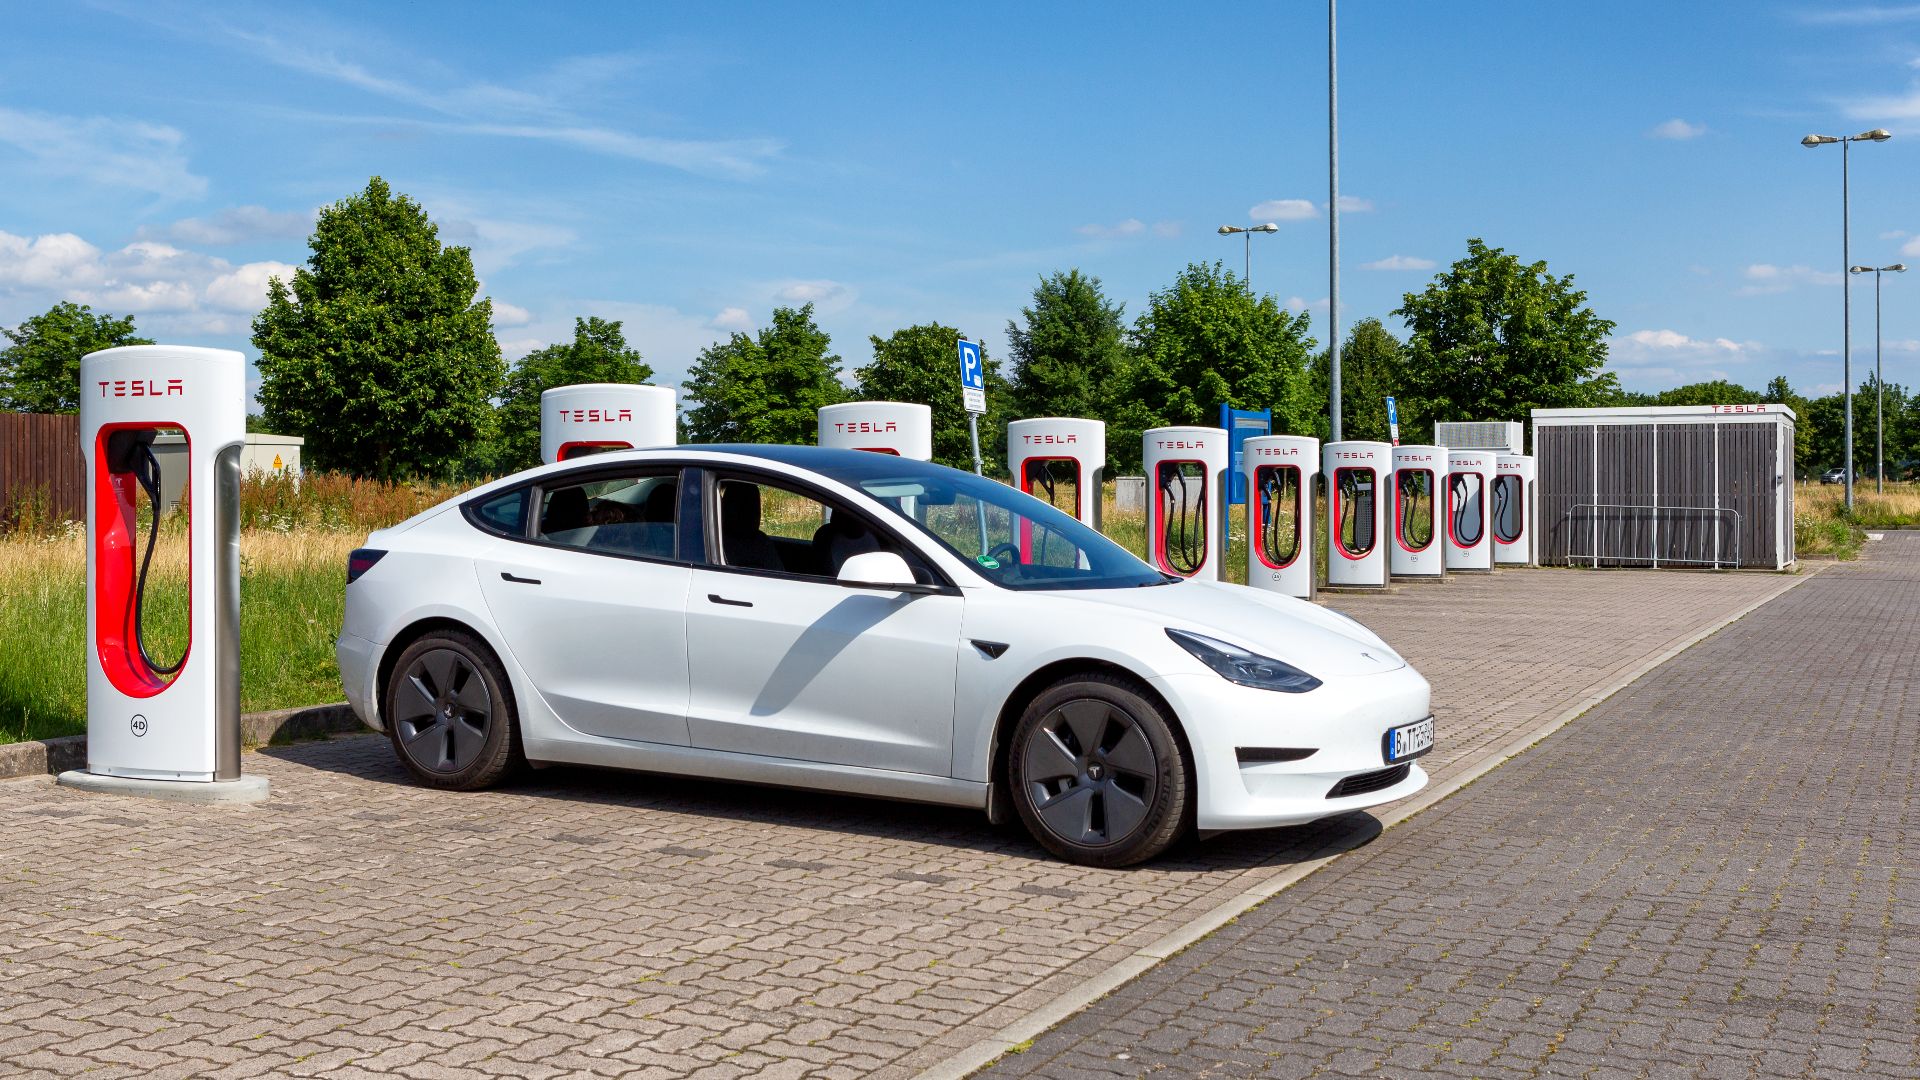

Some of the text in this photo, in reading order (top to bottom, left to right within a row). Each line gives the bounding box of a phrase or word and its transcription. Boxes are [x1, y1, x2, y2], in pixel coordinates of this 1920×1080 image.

[964, 347, 976, 382] P
[98, 380, 182, 397] TESLA
[1712, 404, 1766, 413] TESLA
[559, 409, 632, 422] TESLA
[834, 422, 896, 433] TESLA
[1022, 434, 1077, 445] TESLA
[1157, 441, 1204, 449] TESLA
[1255, 448, 1298, 456] TESLA
[133, 720, 145, 730] 4D
[1396, 731, 1402, 754] B
